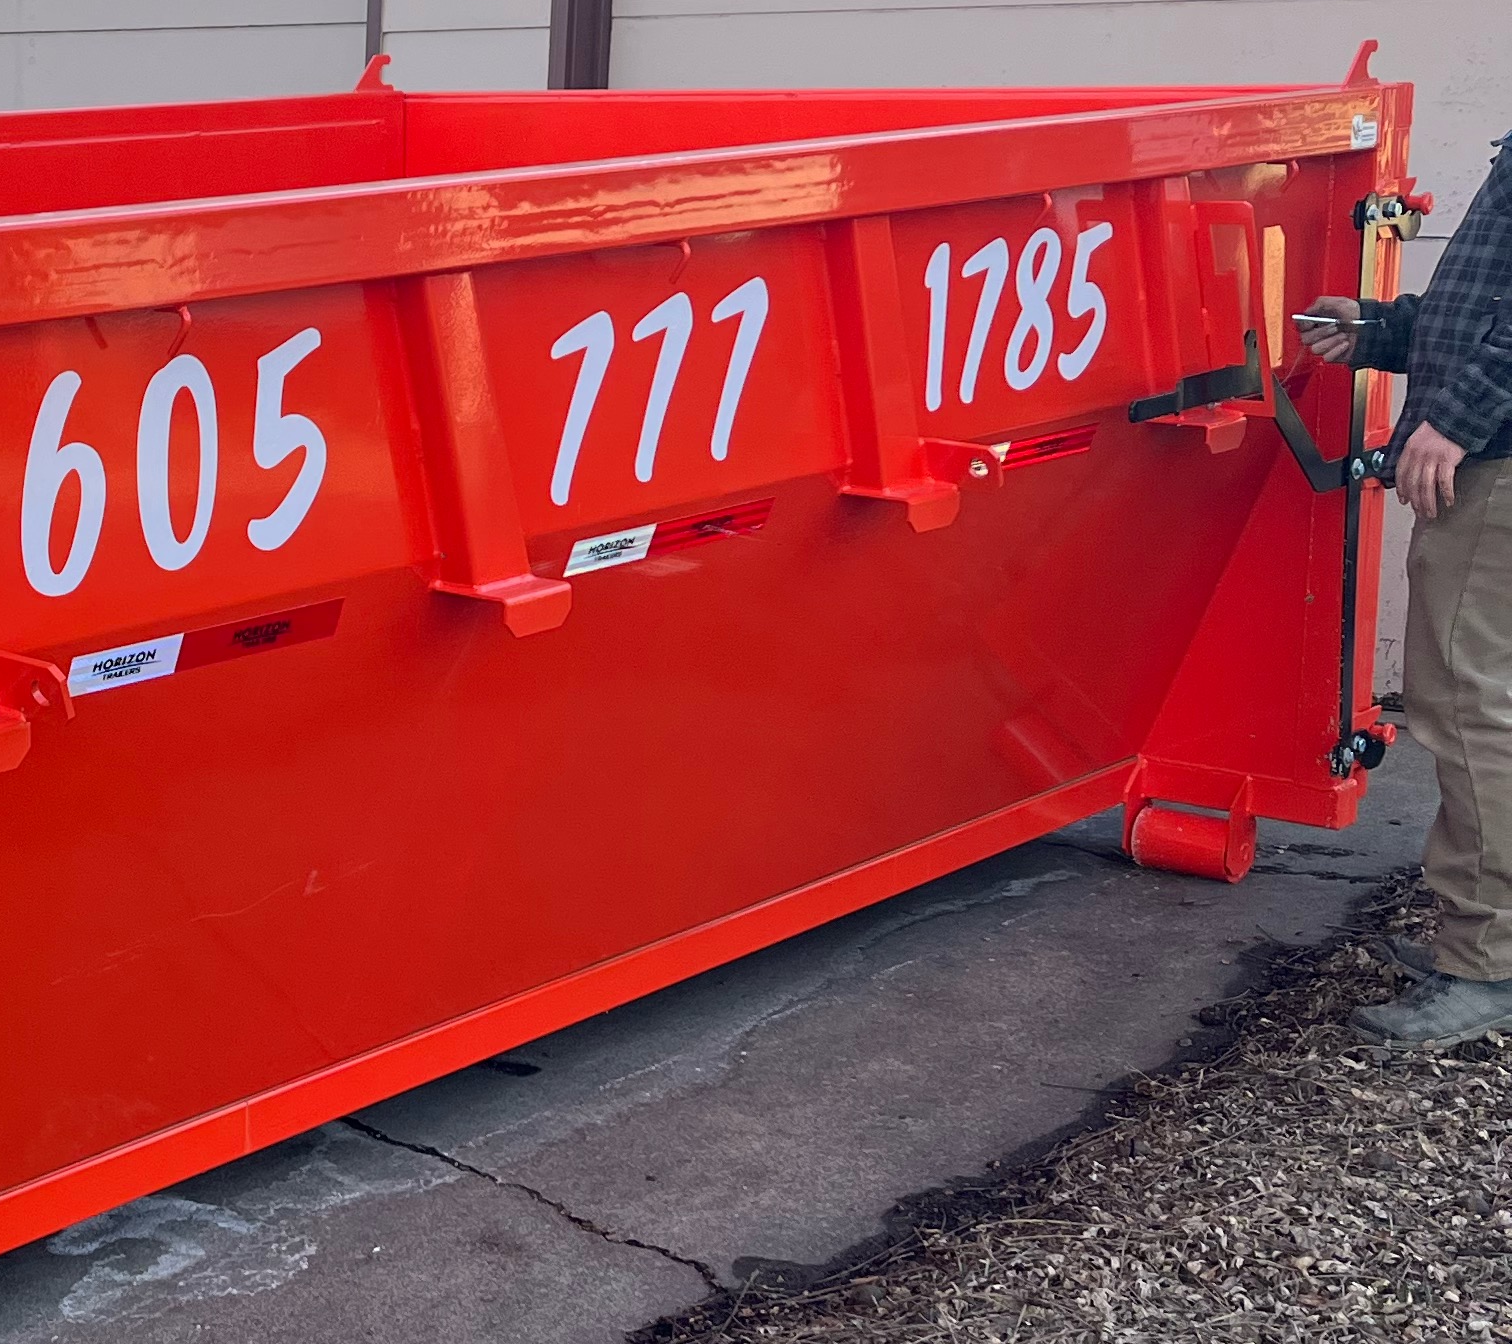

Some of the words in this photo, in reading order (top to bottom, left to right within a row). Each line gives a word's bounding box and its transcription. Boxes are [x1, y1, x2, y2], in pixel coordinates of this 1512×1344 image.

[21, 328, 326, 596] 605
[551, 277, 768, 505] 777
[925, 222, 1112, 411] 1785
[92, 649, 156, 672] HORIZON
